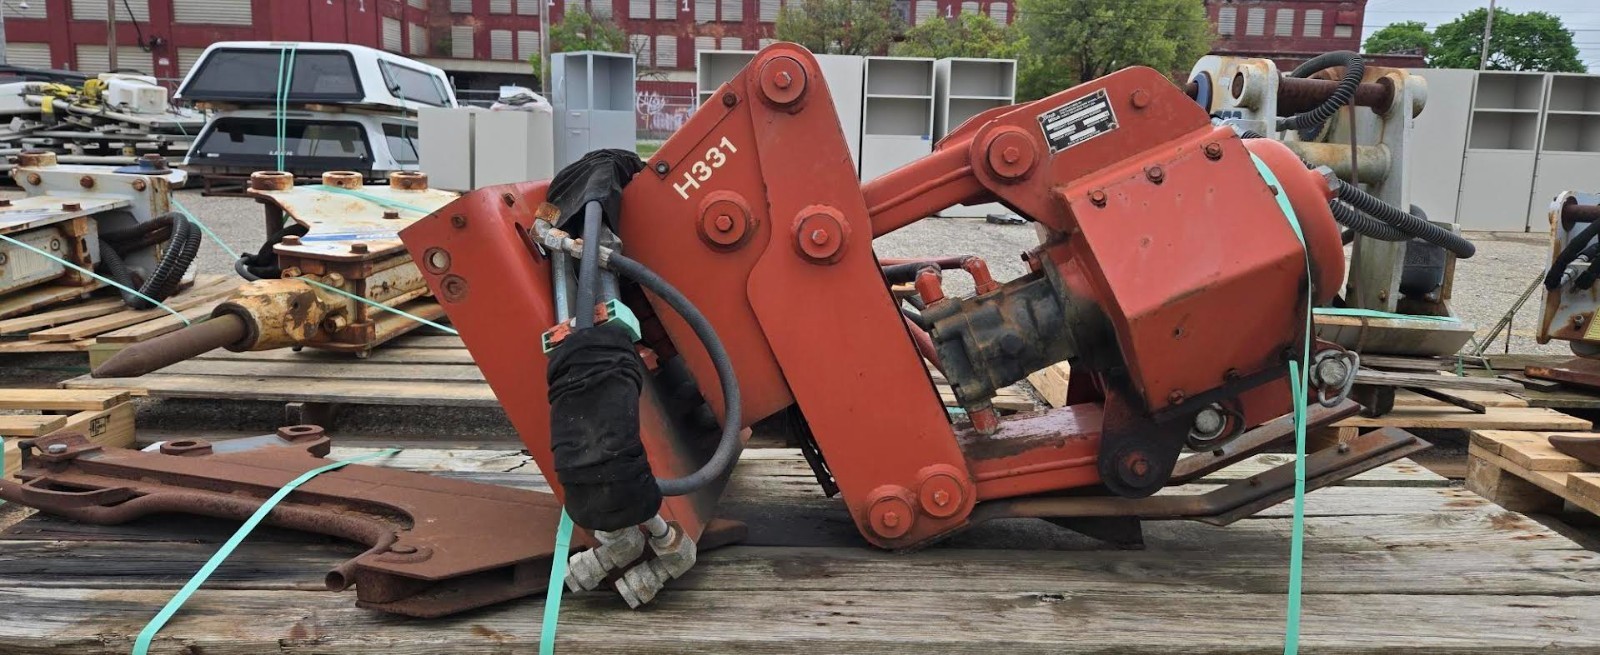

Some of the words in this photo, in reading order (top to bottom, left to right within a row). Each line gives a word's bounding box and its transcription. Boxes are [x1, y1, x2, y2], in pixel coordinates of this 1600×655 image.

[681, 0, 691, 12] 1
[945, 4, 954, 19] 1
[673, 136, 737, 200] H331
